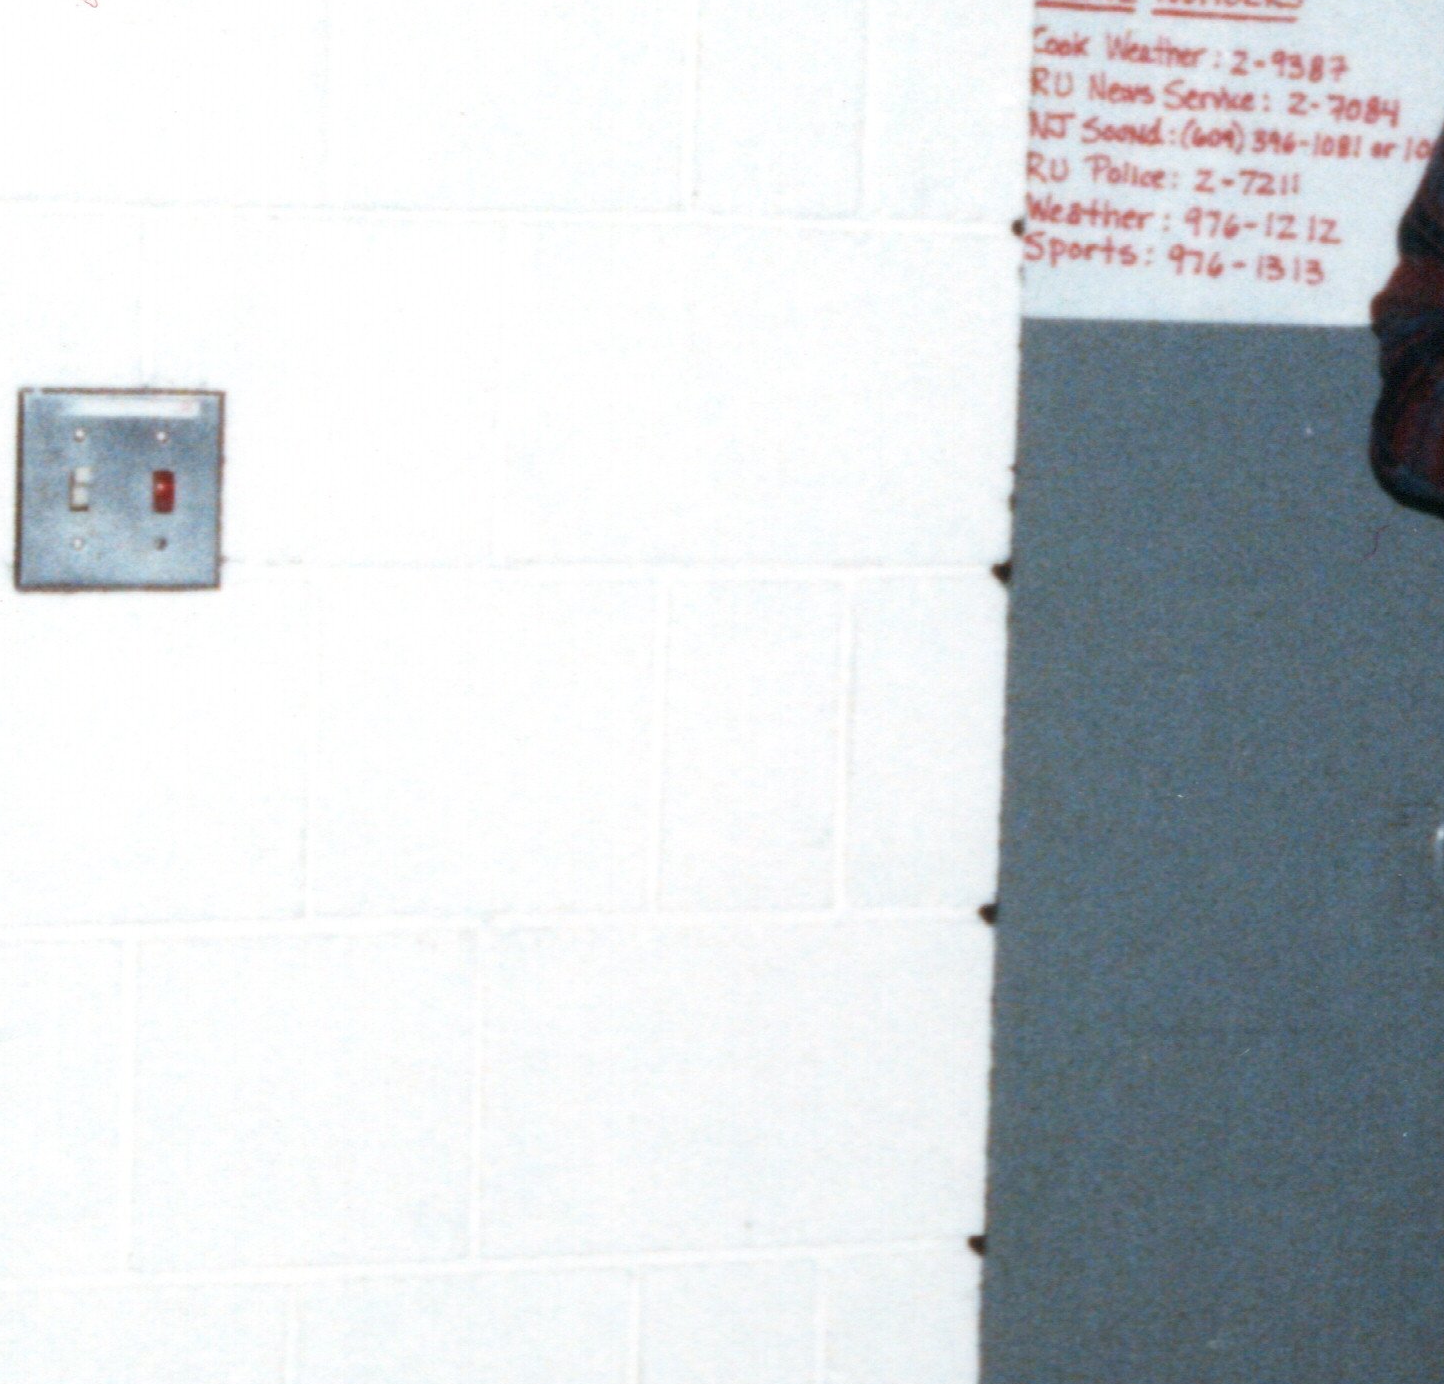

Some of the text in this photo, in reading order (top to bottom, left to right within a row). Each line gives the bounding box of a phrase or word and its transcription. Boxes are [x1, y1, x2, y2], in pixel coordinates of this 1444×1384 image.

[1030, 65, 1075, 99] RU
[1087, 72, 1156, 106] News
[1370, 139, 1399, 160] or
[1026, 149, 1071, 185] RU
[1192, 167, 1302, 197] 2-7211
[1183, 205, 1344, 245] 976-1212
[1167, 242, 1327, 287] 976-1313
